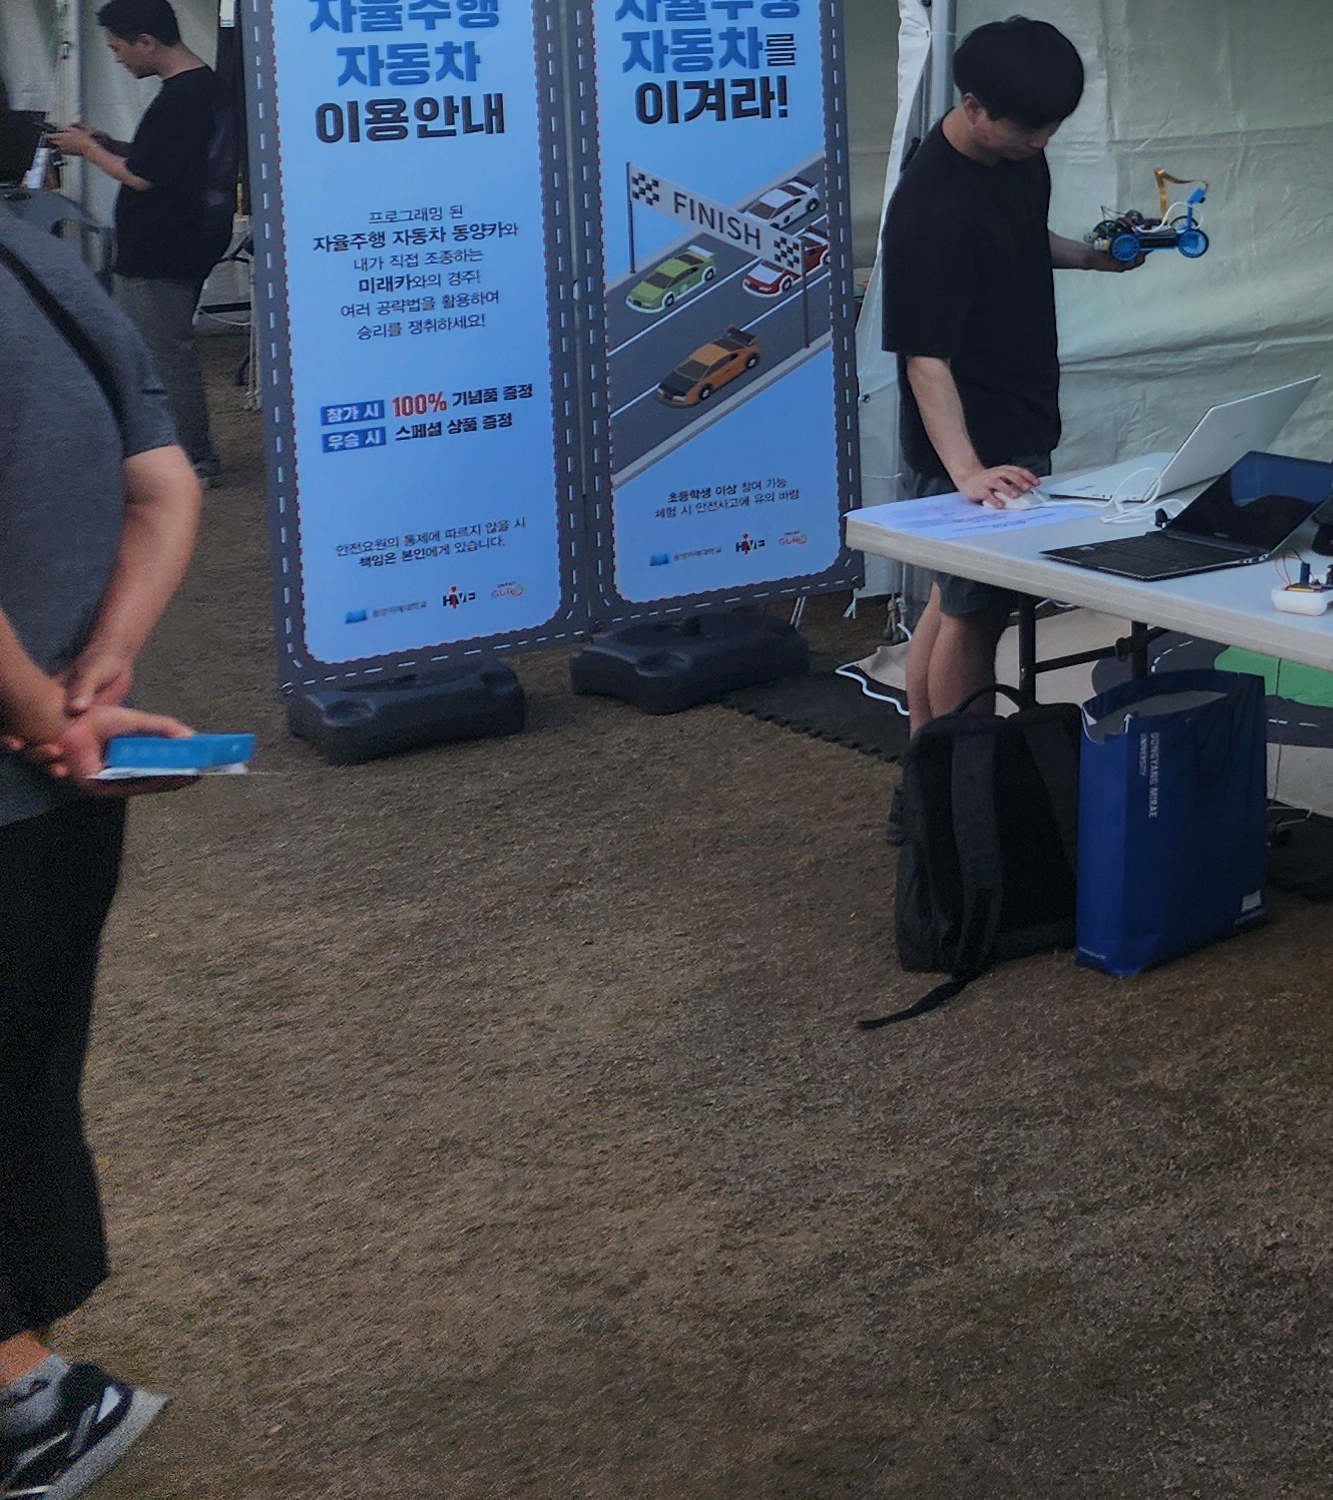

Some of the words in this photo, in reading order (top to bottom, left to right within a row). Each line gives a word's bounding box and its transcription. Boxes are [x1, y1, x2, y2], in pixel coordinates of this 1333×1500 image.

[336, 40, 481, 88] 자동차
[622, 25, 797, 75] 자동차를
[634, 75, 787, 126] 이겨라!
[314, 93, 505, 145] 이용안내
[369, 206, 445, 226] 프로그래밍
[450, 204, 464, 221] 된
[673, 191, 762, 249] FINISH
[313, 228, 387, 254] 자율주행
[391, 225, 447, 248] 자동차
[451, 220, 519, 245] 동양카와
[353, 254, 386, 273] 내가
[390, 252, 420, 271] 직접
[424, 246, 484, 269] 조종하는
[358, 270, 443, 293] 미래카와의
[446, 267, 481, 289] 경주!
[340, 299, 372, 319] 여러
[376, 294, 437, 317] 공략법을
[440, 290, 500, 313] 활용하여
[356, 319, 403, 341] 승리를
[407, 313, 486, 337] 쟁취하세요!
[326, 404, 359, 424] 참가
[364, 402, 381, 420] 시
[391, 390, 447, 418] 100%
[452, 386, 498, 408] 기념품
[501, 381, 534, 402] 증정
[327, 432, 361, 452] 우승
[365, 429, 382, 448] 시
[394, 419, 444, 442] 스페셜
[446, 416, 478, 437] 상품
[481, 411, 513, 432] 증정
[714, 480, 737, 498] 이상
[740, 478, 762, 495] 참여
[765, 475, 787, 493] 가능
[654, 500, 678, 520] 체험
[681, 500, 692, 517] 시
[753, 491, 775, 509] 유의
[778, 488, 800, 506] 바람
[335, 536, 400, 558] 안전요원의
[445, 525, 482, 546] 따르지
[484, 519, 510, 539] 않을
[514, 515, 526, 533] 시
[358, 546, 397, 567] 책임은
[400, 541, 450, 564] 본인에게
[453, 535, 506, 558] 있습니다.
[1149, 732, 1159, 786] DONGYANG
[1148, 787, 1159, 818] MIRAE
